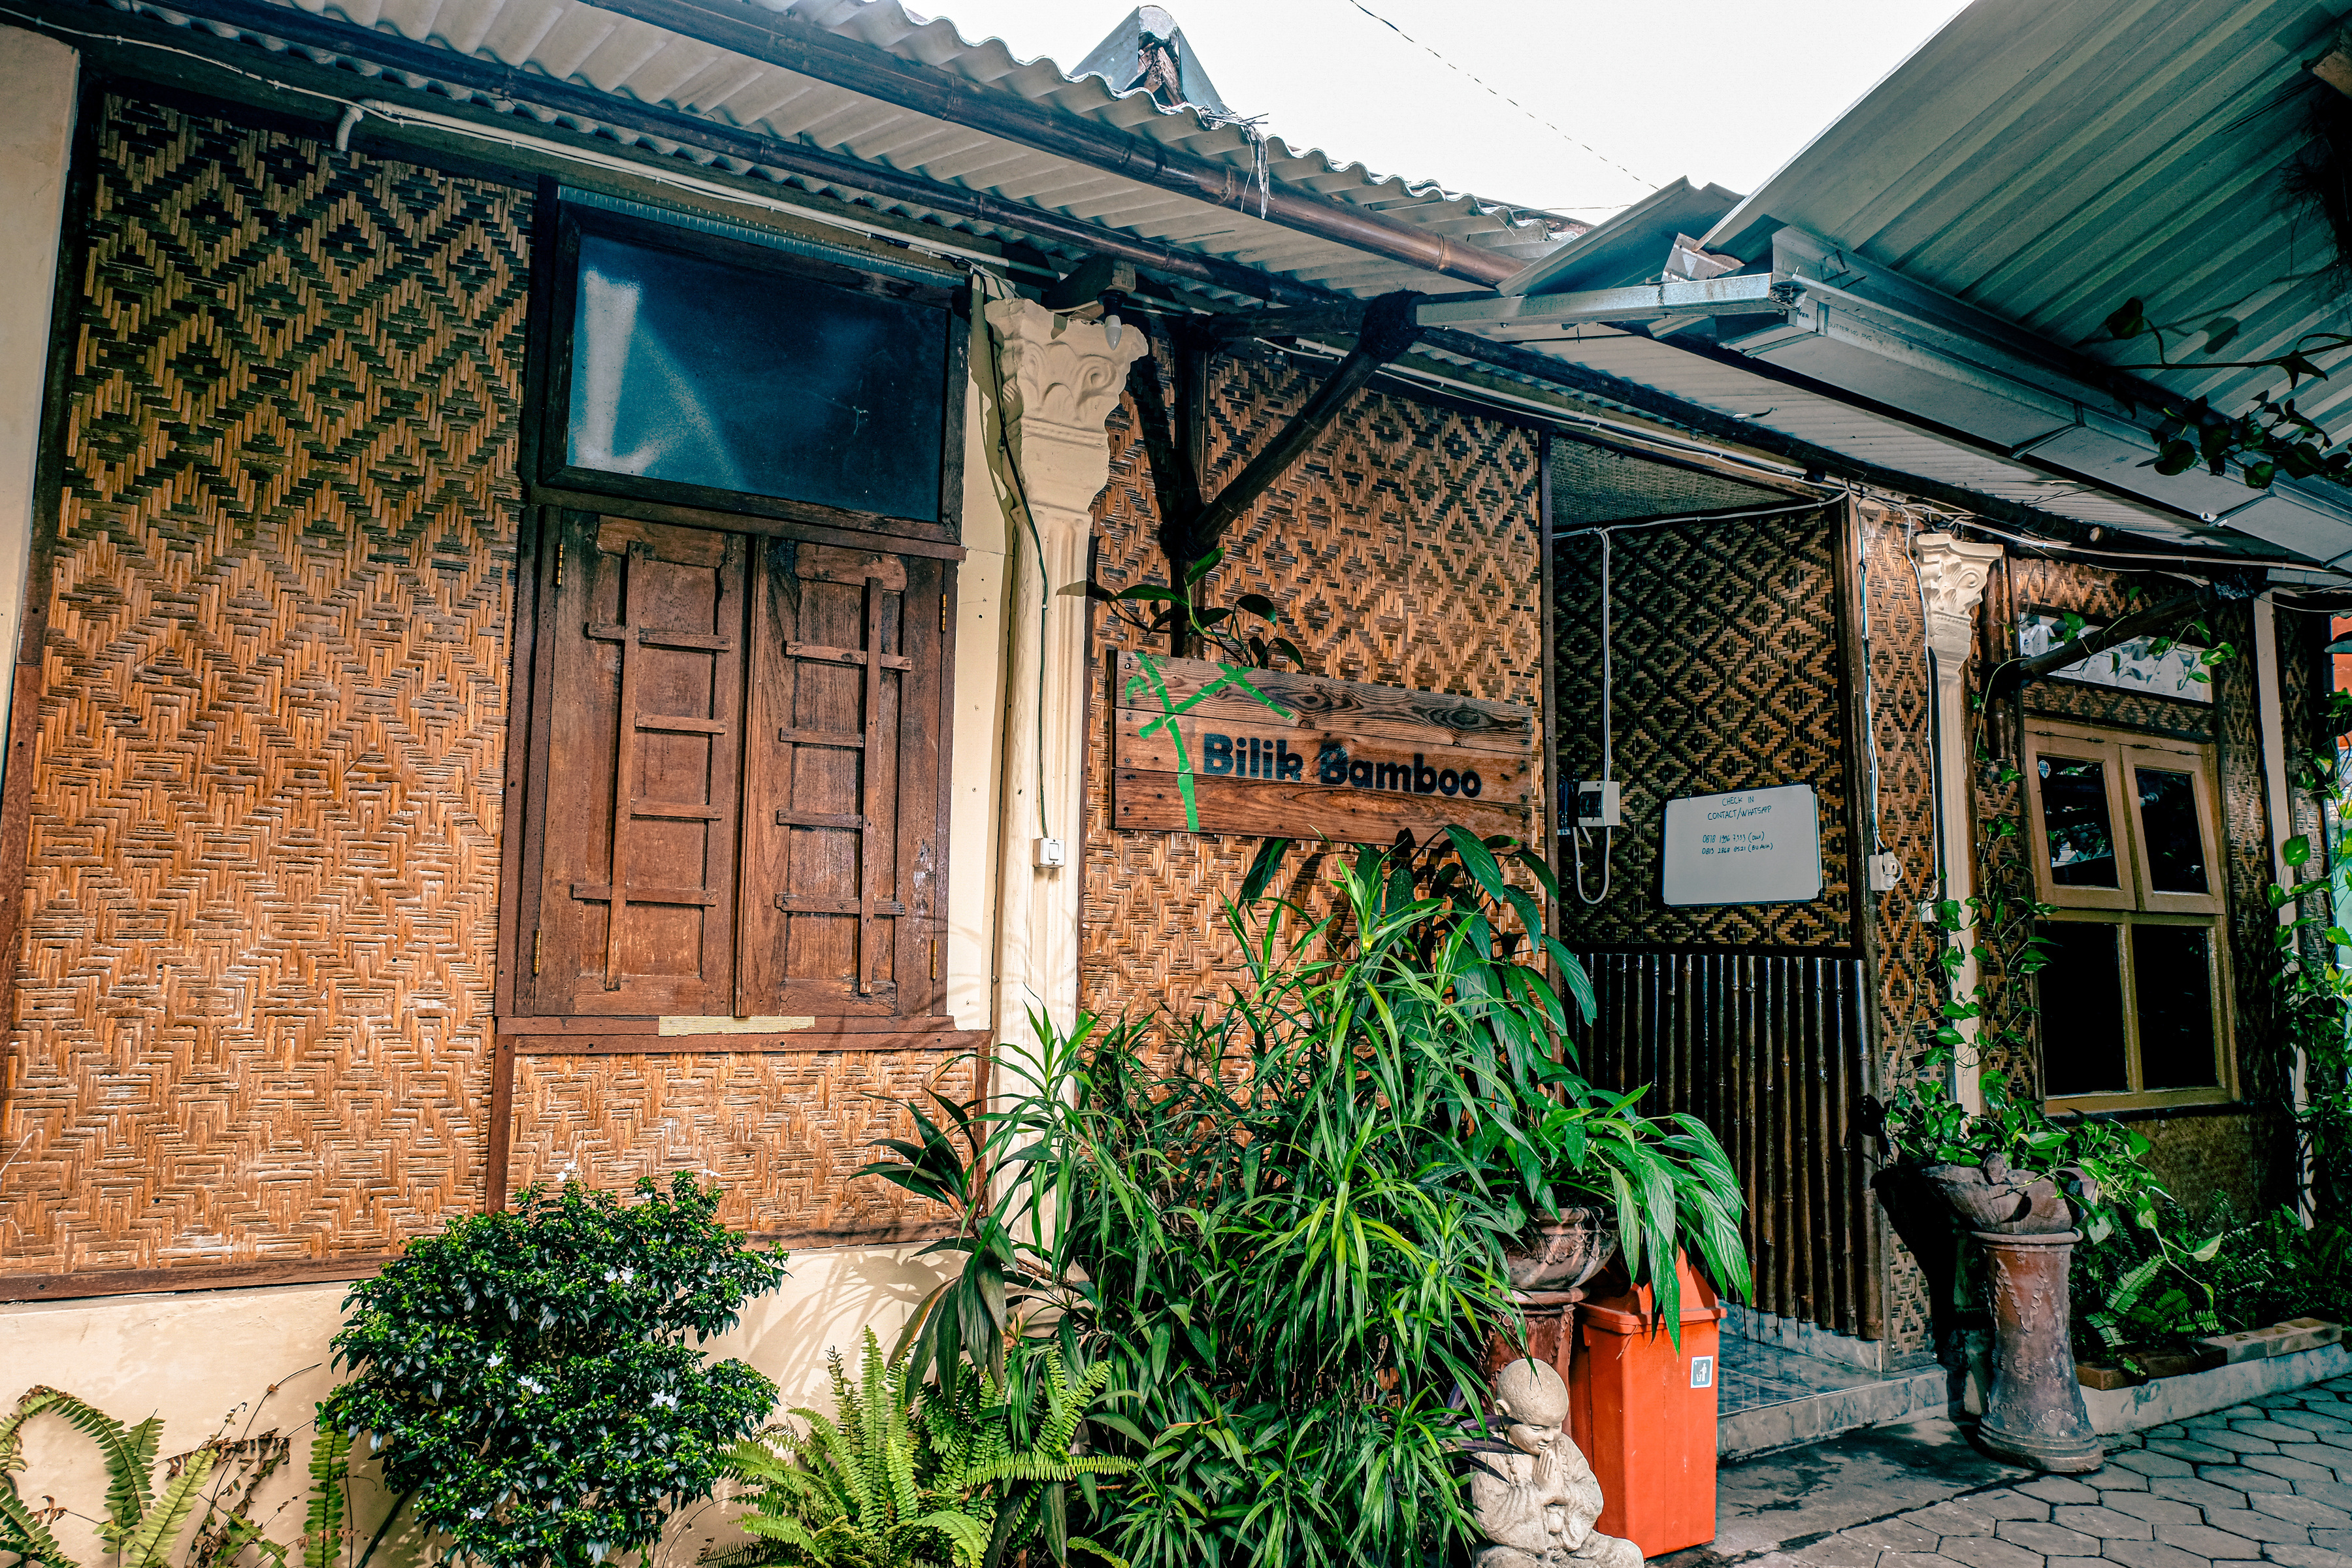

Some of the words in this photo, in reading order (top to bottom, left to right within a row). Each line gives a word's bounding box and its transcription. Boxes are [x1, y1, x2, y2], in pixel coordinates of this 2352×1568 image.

[1203, 733, 1304, 781] Bilik
[1320, 743, 1482, 798] Bamboo
[1722, 796, 1743, 806] CHECK
[1707, 805, 1772, 821] CONTACT/WHATSAPP
